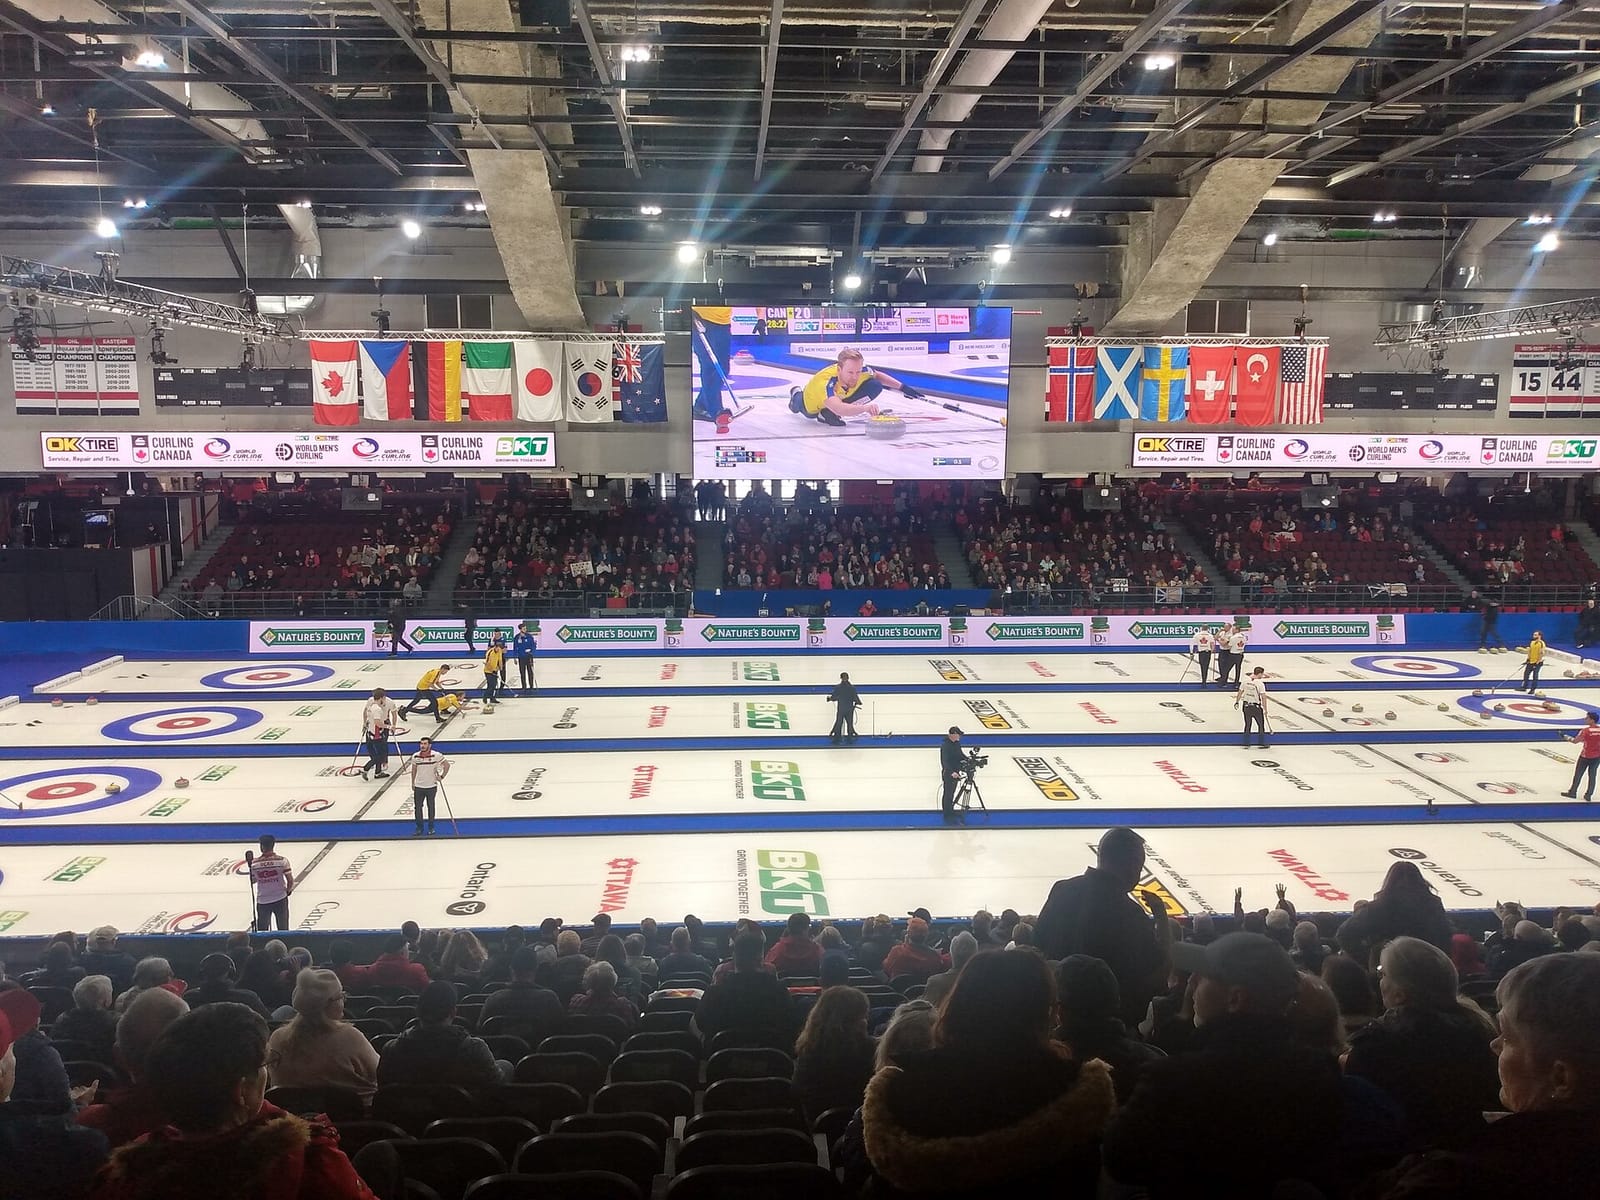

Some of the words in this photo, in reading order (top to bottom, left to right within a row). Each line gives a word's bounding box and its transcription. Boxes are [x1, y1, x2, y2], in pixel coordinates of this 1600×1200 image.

[767, 307, 786, 318] CAN
[893, 307, 901, 318] 2
[794, 321, 820, 331] BKT
[1519, 372, 1541, 392] 15
[1551, 371, 1582, 391] 44
[46, 437, 82, 452] OK
[85, 439, 116, 450] TIRE
[152, 437, 193, 448] CURLING
[295, 444, 318, 452] WORLD
[319, 444, 339, 452] MEN'S
[441, 437, 483, 448] CURLING
[496, 437, 548, 456] BKT
[1138, 437, 1172, 452] OK
[1175, 439, 1203, 450] TIRE
[1236, 438, 1275, 449] CURLING
[1499, 439, 1537, 450] CURLING
[1547, 439, 1598, 457] BKT
[153, 449, 192, 461] CANADA
[295, 452, 323, 460] CURLING
[443, 450, 482, 461] CANADA
[1235, 450, 1272, 461] CANADA
[1498, 451, 1534, 462] CANADA
[278, 631, 321, 642] NATURE'S
[324, 631, 363, 642] BOUNTY
[428, 630, 465, 640] NATURE
[574, 629, 616, 639] NATURE'S
[618, 629, 654, 639] BOUNTY
[718, 627, 759, 638] NATURE'S
[761, 627, 798, 638] BOUNTY
[861, 626, 901, 637] NATURE'S
[903, 626, 939, 637] BOUNTY
[1002, 625, 1043, 636] NATURE'S
[1045, 625, 1081, 636] BOUNTY
[1145, 625, 1186, 636] NATURE'S
[1290, 625, 1330, 635] NATURE'S
[1332, 625, 1368, 635] BOUNTY
[744, 661, 781, 681] BKT
[746, 702, 790, 730] BKT
[1018, 758, 1052, 775] TIRE
[521, 767, 547, 791] Ontario
[629, 764, 660, 800] OTTAWA
[750, 759, 806, 801] BKT
[1153, 759, 1208, 793] OTTAWA
[1272, 768, 1314, 791] Ontario
[1030, 777, 1080, 801] OK
[338, 849, 382, 881] Canada
[736, 849, 747, 877] GROWING
[459, 862, 497, 900] Ontario
[756, 849, 831, 916] BKT
[1266, 848, 1350, 902] OTTAWA
[1420, 860, 1484, 897] Ontario
[597, 857, 640, 914] OTTAWA
[737, 878, 750, 915] TOGETHER
[0, 910, 30, 932] BK
